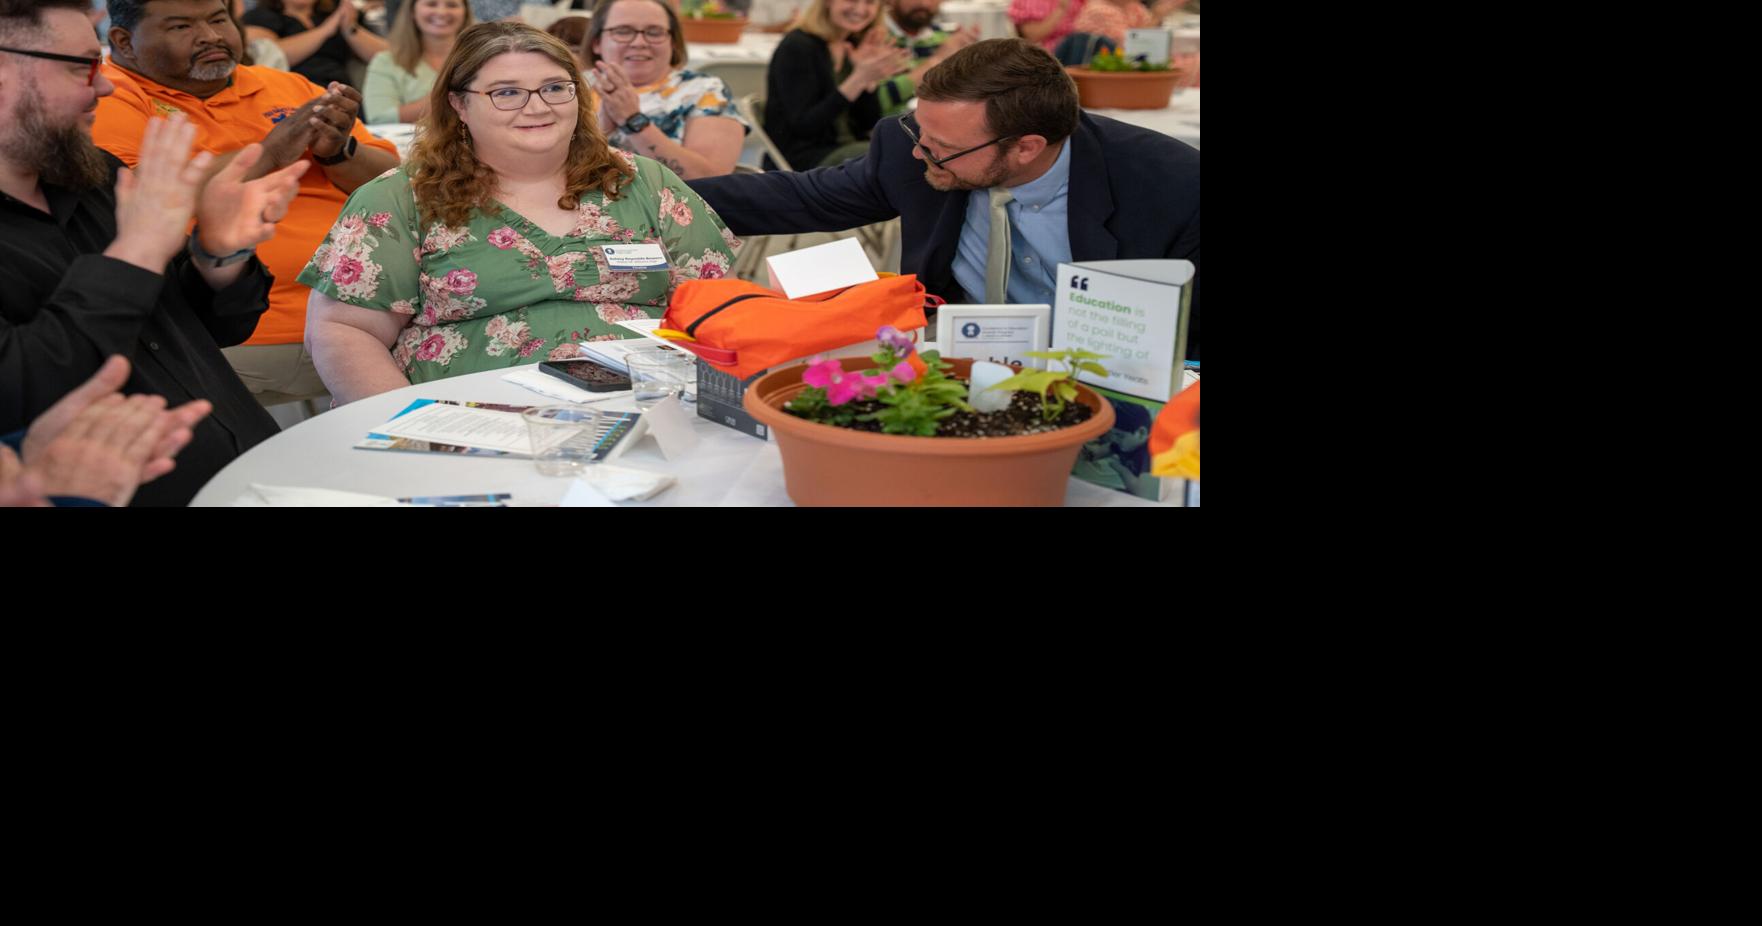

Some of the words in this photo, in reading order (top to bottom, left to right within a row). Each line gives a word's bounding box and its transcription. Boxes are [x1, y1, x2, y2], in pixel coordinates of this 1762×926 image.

[1069, 292, 1132, 315] Education
[1135, 306, 1145, 317] is
[1067, 319, 1079, 328] of
[1080, 323, 1089, 332] a
[1117, 331, 1139, 344] but
[1068, 306, 1087, 318] not
[1090, 310, 1109, 323] the
[1113, 315, 1146, 334] filling
[1066, 331, 1085, 344] the
[1088, 336, 1132, 359] lighting
[1136, 350, 1150, 360] of
